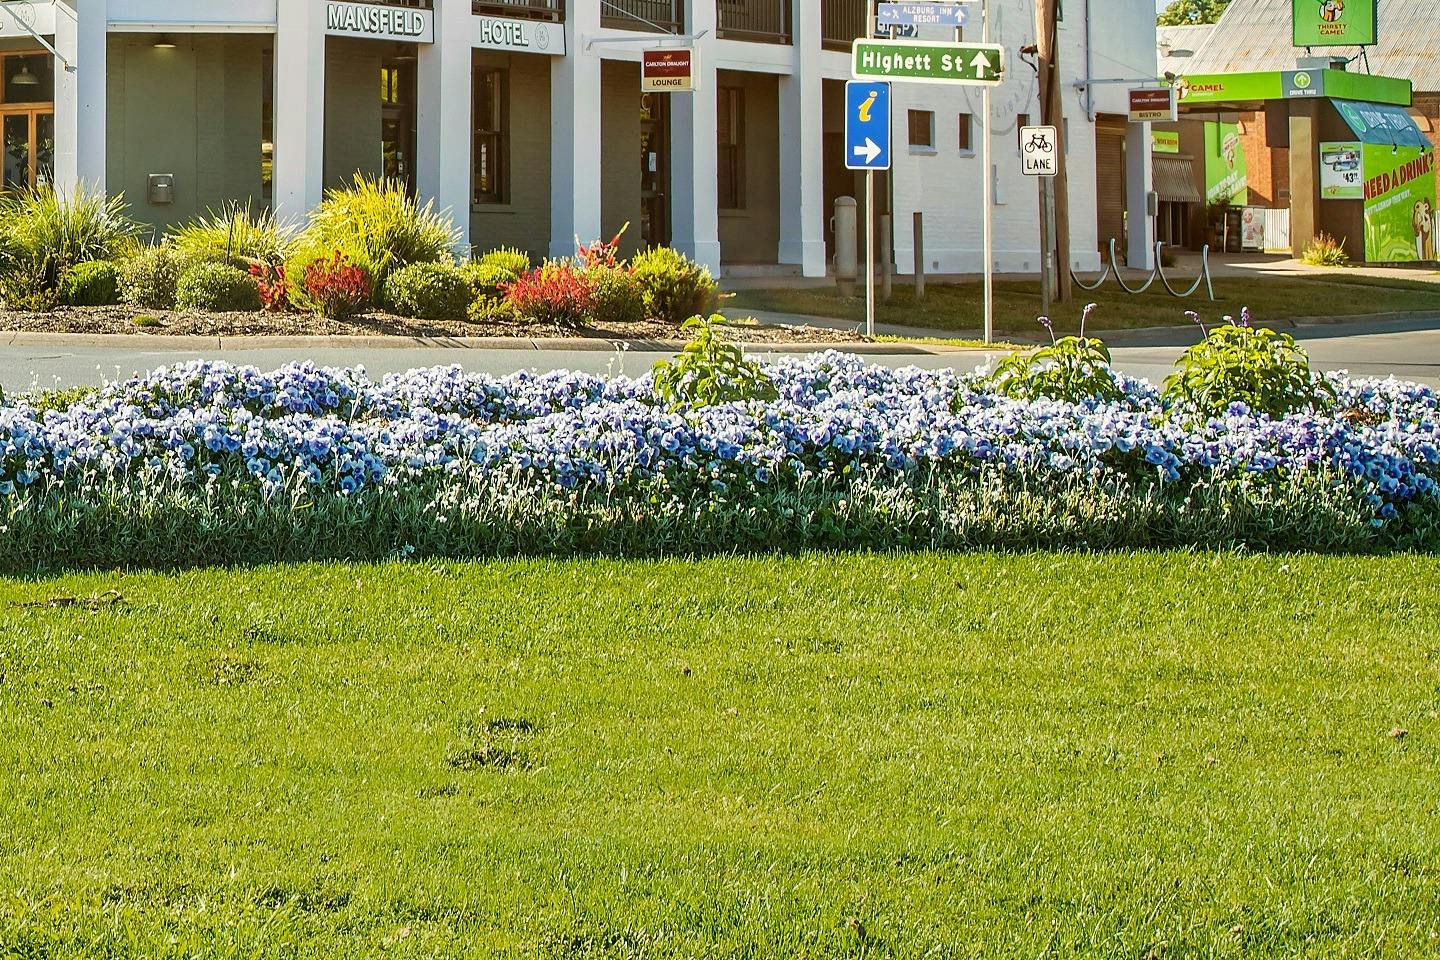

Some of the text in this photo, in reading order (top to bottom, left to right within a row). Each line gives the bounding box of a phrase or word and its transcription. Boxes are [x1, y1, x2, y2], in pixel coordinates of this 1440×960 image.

[902, 6, 952, 16] ALZBURG INN
[327, 4, 425, 37] MANSFIELD
[913, 15, 940, 23] RESORT
[480, 19, 529, 47] HOTEL
[862, 50, 963, 73] Highett St
[652, 78, 683, 86] LOUNGE
[1191, 83, 1224, 92] CAMEL
[1026, 158, 1051, 170] LANE
[1363, 152, 1434, 201] NEED A DRINK?
